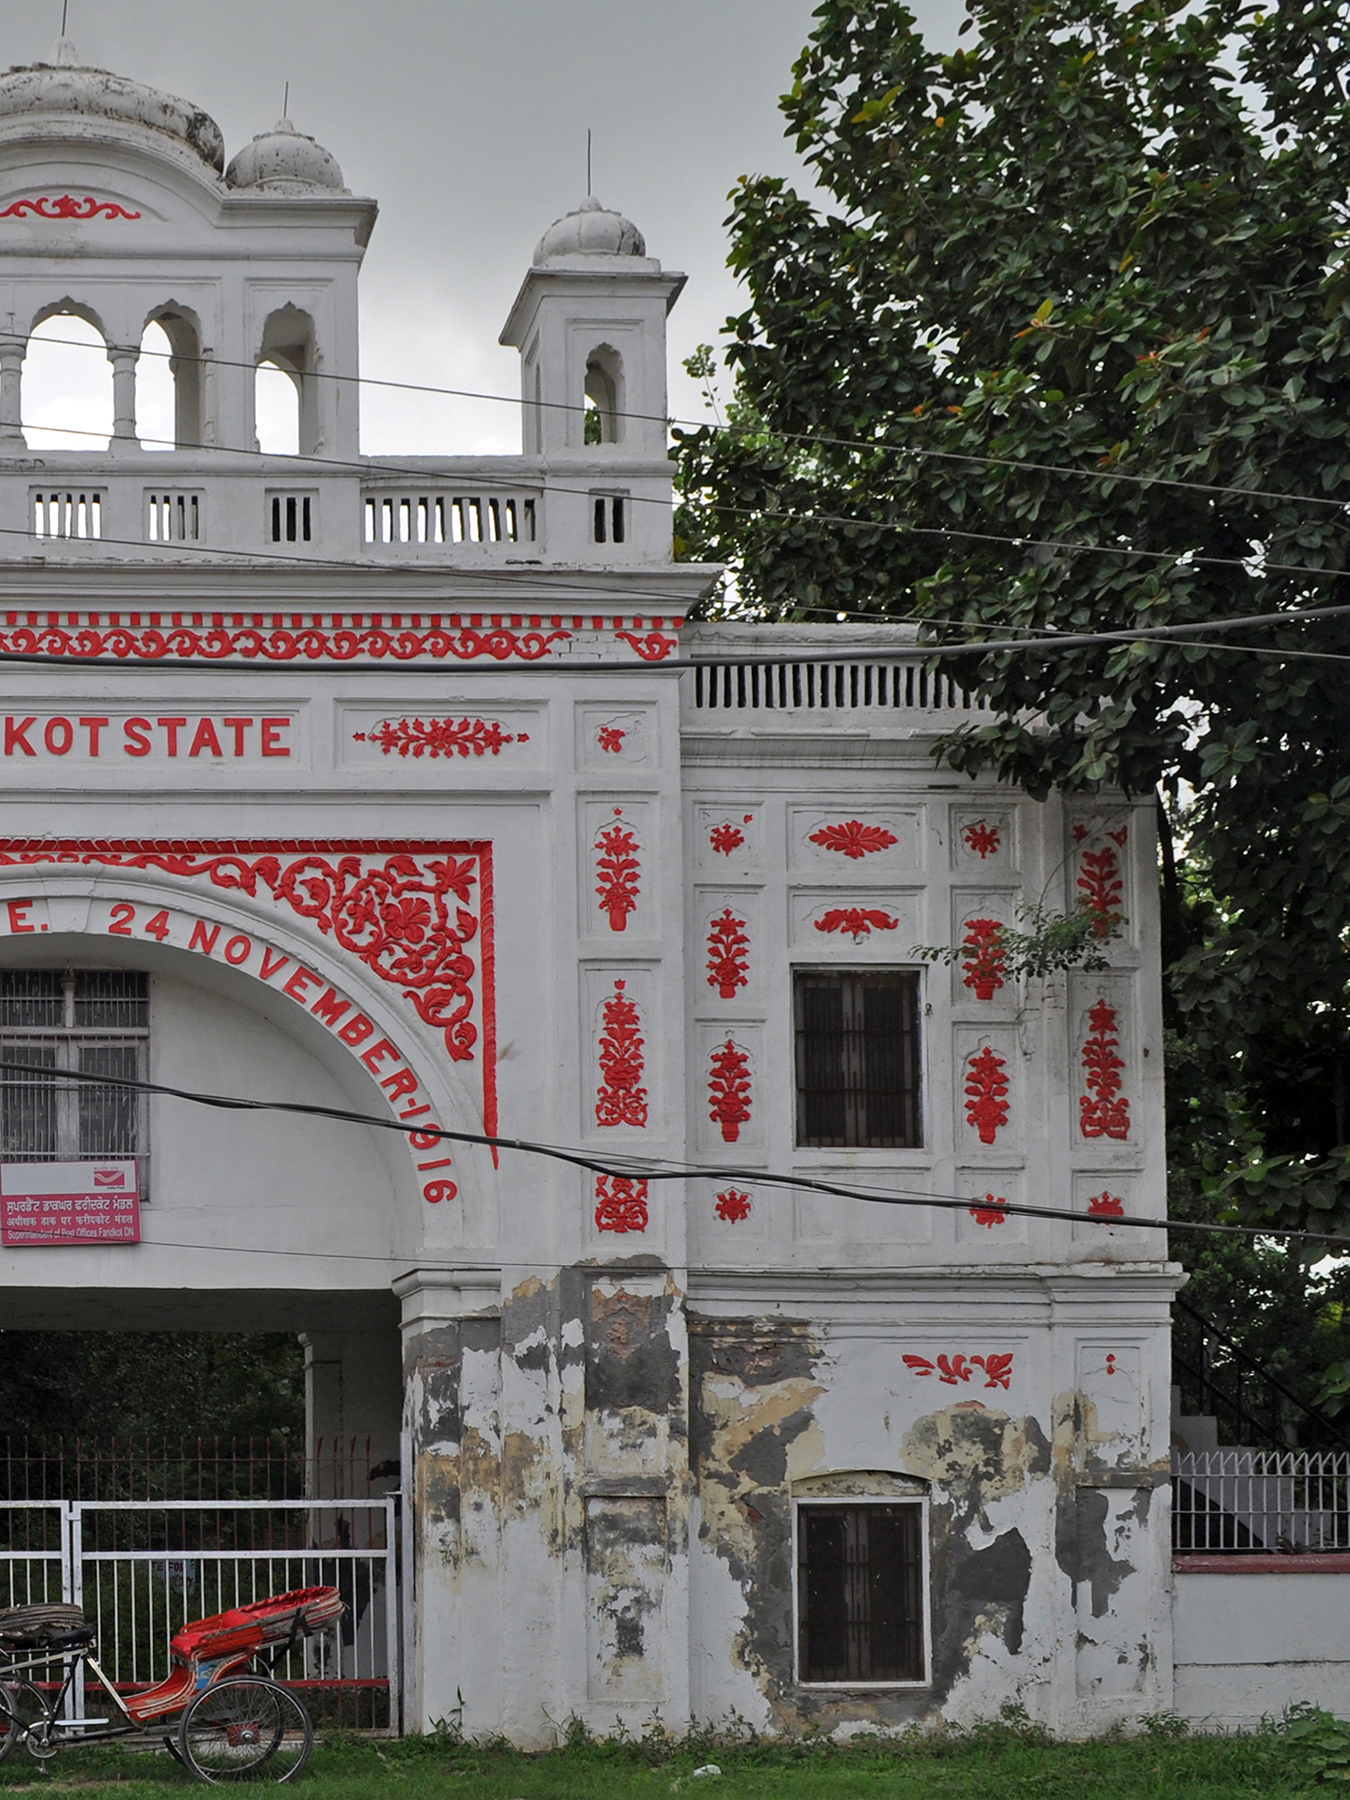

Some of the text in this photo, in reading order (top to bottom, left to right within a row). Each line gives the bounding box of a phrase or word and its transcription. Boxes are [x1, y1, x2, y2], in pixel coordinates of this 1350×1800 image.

[123, 717, 291, 757] STATE
[108, 903, 170, 941] 24
[40, 1216, 57, 1226] डाक
[60, 1216, 72, 1226] घर
[76, 1228, 97, 1238] Offices
[98, 1227, 123, 1238] Faridkot
[124, 1226, 134, 1237] DN
